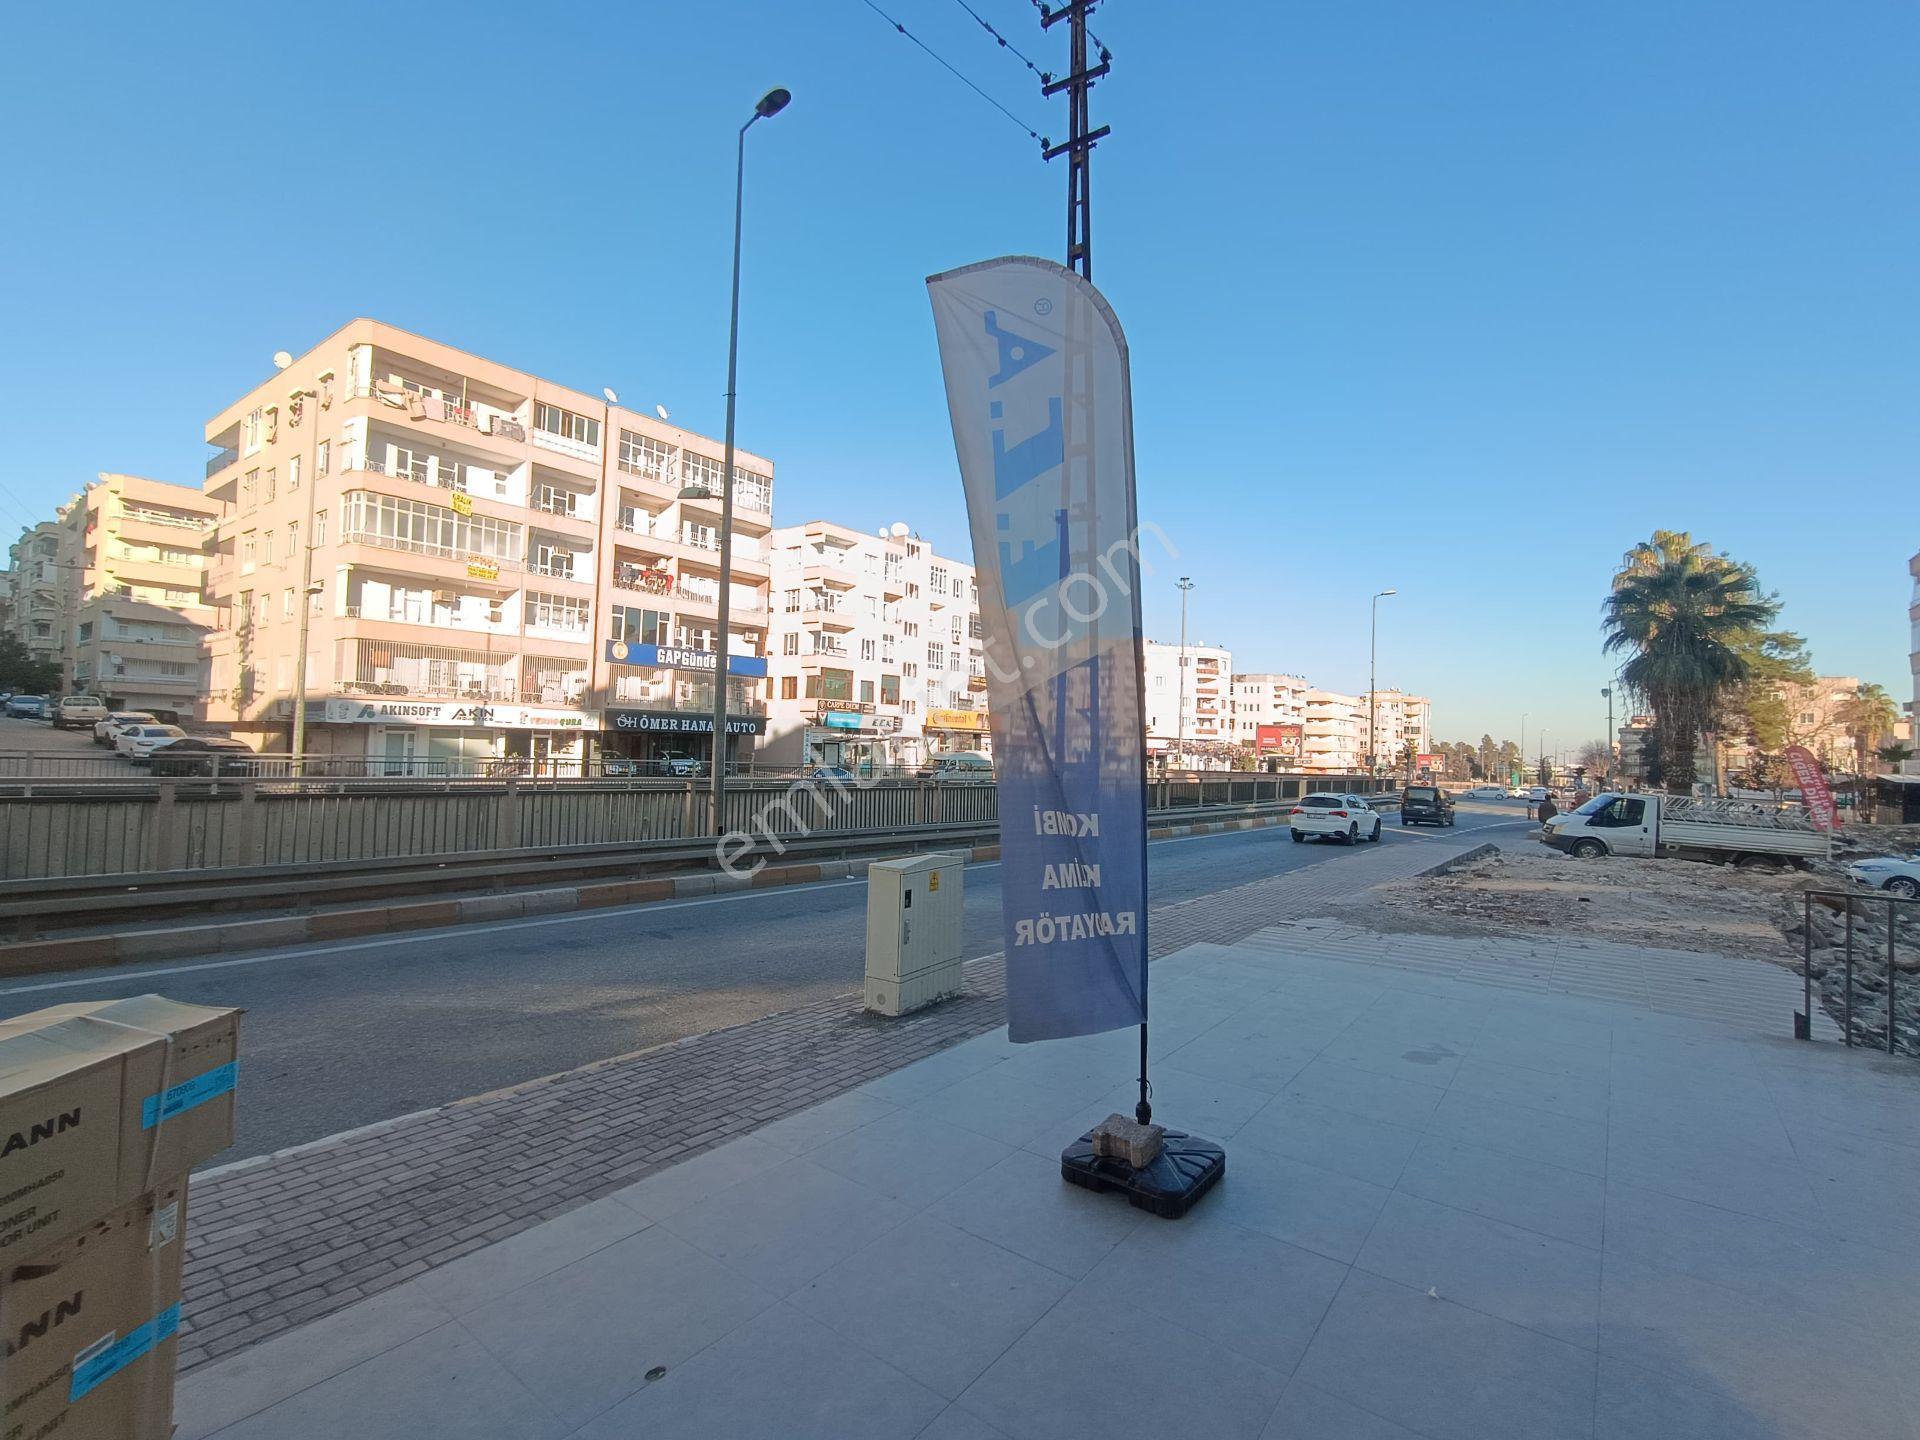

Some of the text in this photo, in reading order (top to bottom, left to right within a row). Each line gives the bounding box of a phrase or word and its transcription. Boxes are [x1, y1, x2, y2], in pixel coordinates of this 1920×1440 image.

[657, 648, 731, 671] GAPGündei
[380, 704, 442, 717] AKINSOFT
[451, 707, 495, 720] AKIN
[639, 713, 679, 731] ÖMER
[725, 721, 757, 734] AUTO
[0, 1107, 82, 1159] ANN
